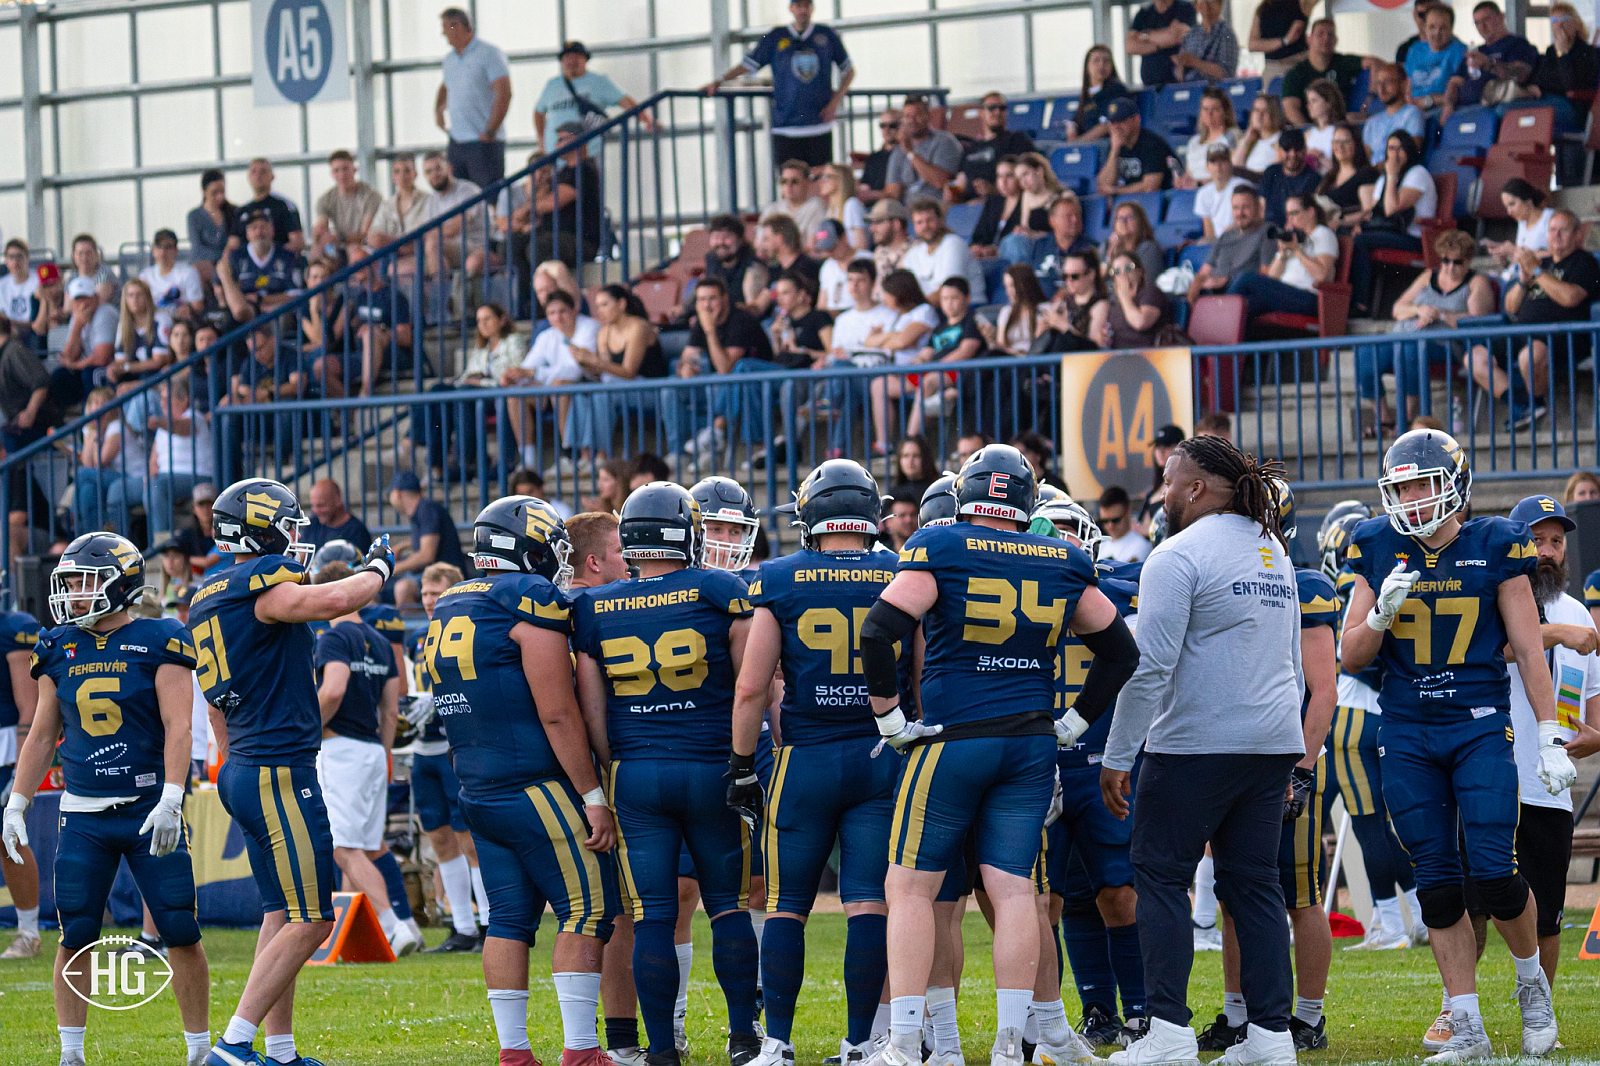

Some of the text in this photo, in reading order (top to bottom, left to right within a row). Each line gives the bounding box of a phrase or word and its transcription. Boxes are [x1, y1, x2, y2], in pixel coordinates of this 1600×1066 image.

[277, 5, 322, 82] A5
[1097, 381, 1154, 470] A4
[988, 472, 1010, 498] E
[973, 504, 1017, 519] Riddell
[826, 522, 868, 532] Riddell
[630, 550, 665, 558] Riddell
[966, 537, 1068, 560] ENTHRONERS
[794, 568, 898, 584] ENTHRONER
[594, 588, 700, 614] ENTHRONERS
[963, 577, 1067, 648] 34
[1390, 597, 1480, 665] 97
[191, 615, 231, 693] 51
[600, 627, 710, 697] 38
[815, 685, 869, 696] SKOD
[815, 696, 870, 706] WOLFAU
[1419, 689, 1457, 699] MET
[75, 677, 124, 737] 6
[95, 765, 132, 776] MET
